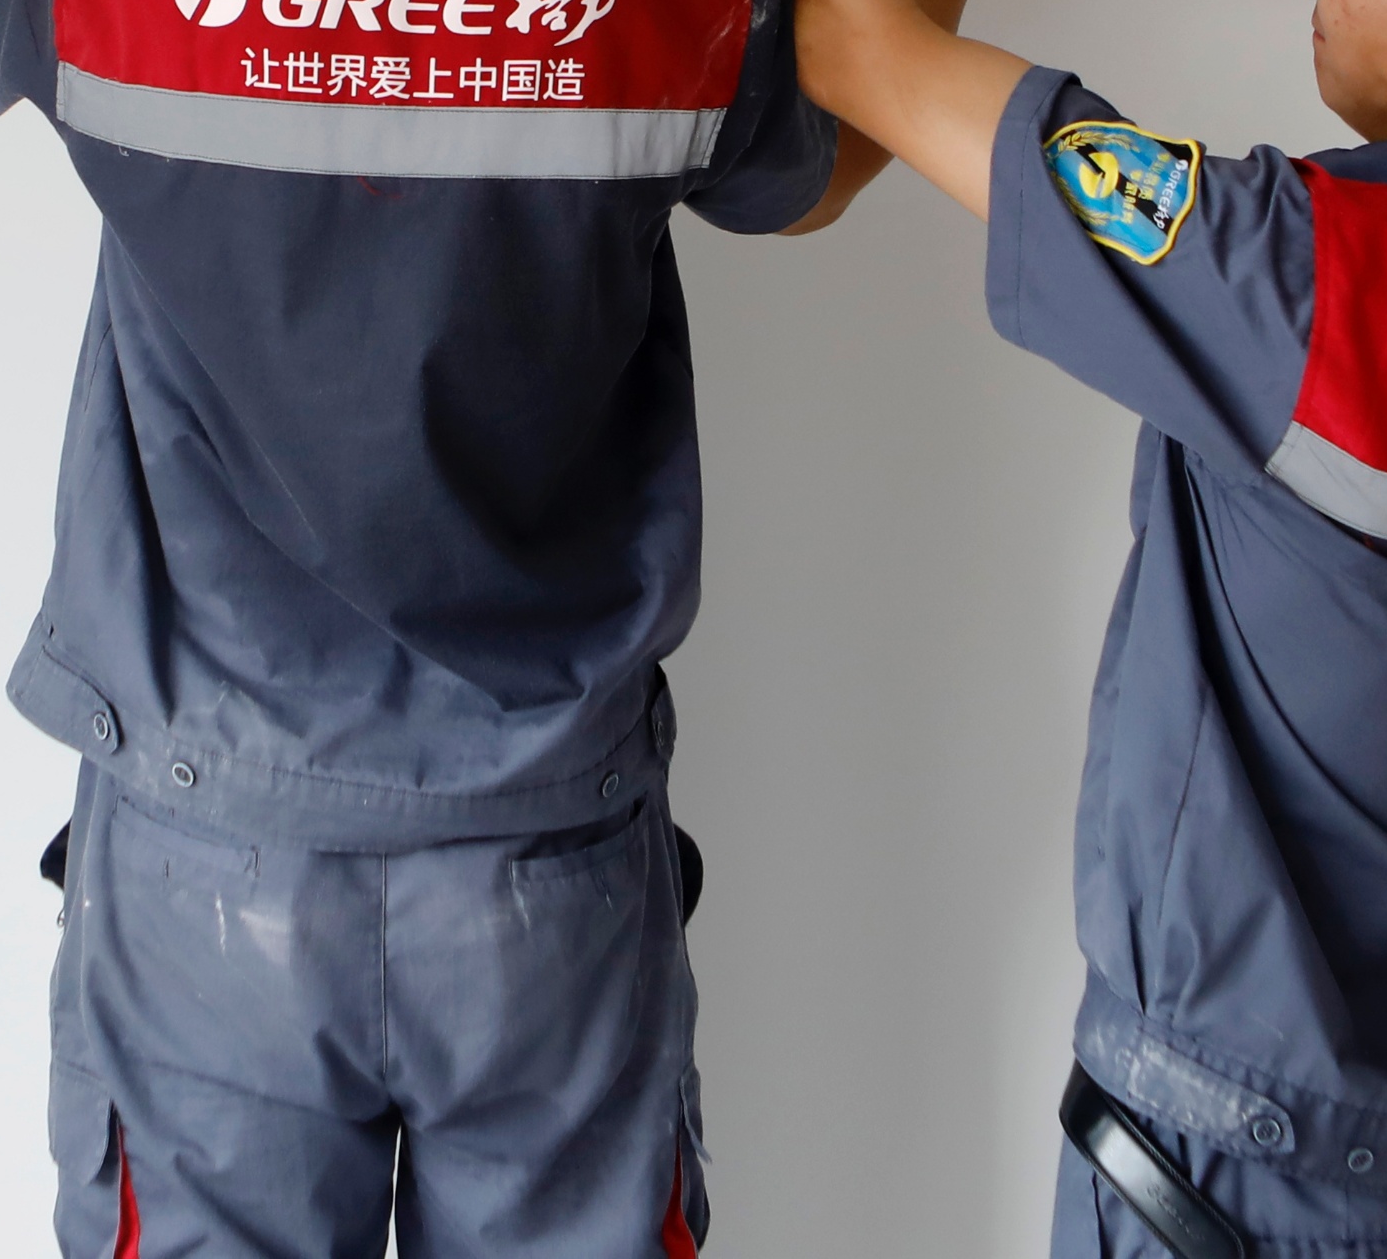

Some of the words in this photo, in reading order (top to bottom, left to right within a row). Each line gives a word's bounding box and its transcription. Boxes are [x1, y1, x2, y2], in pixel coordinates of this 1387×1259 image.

[240, 47, 585, 102] 让世界爱上中国造
[1159, 171, 1182, 208] GREE
